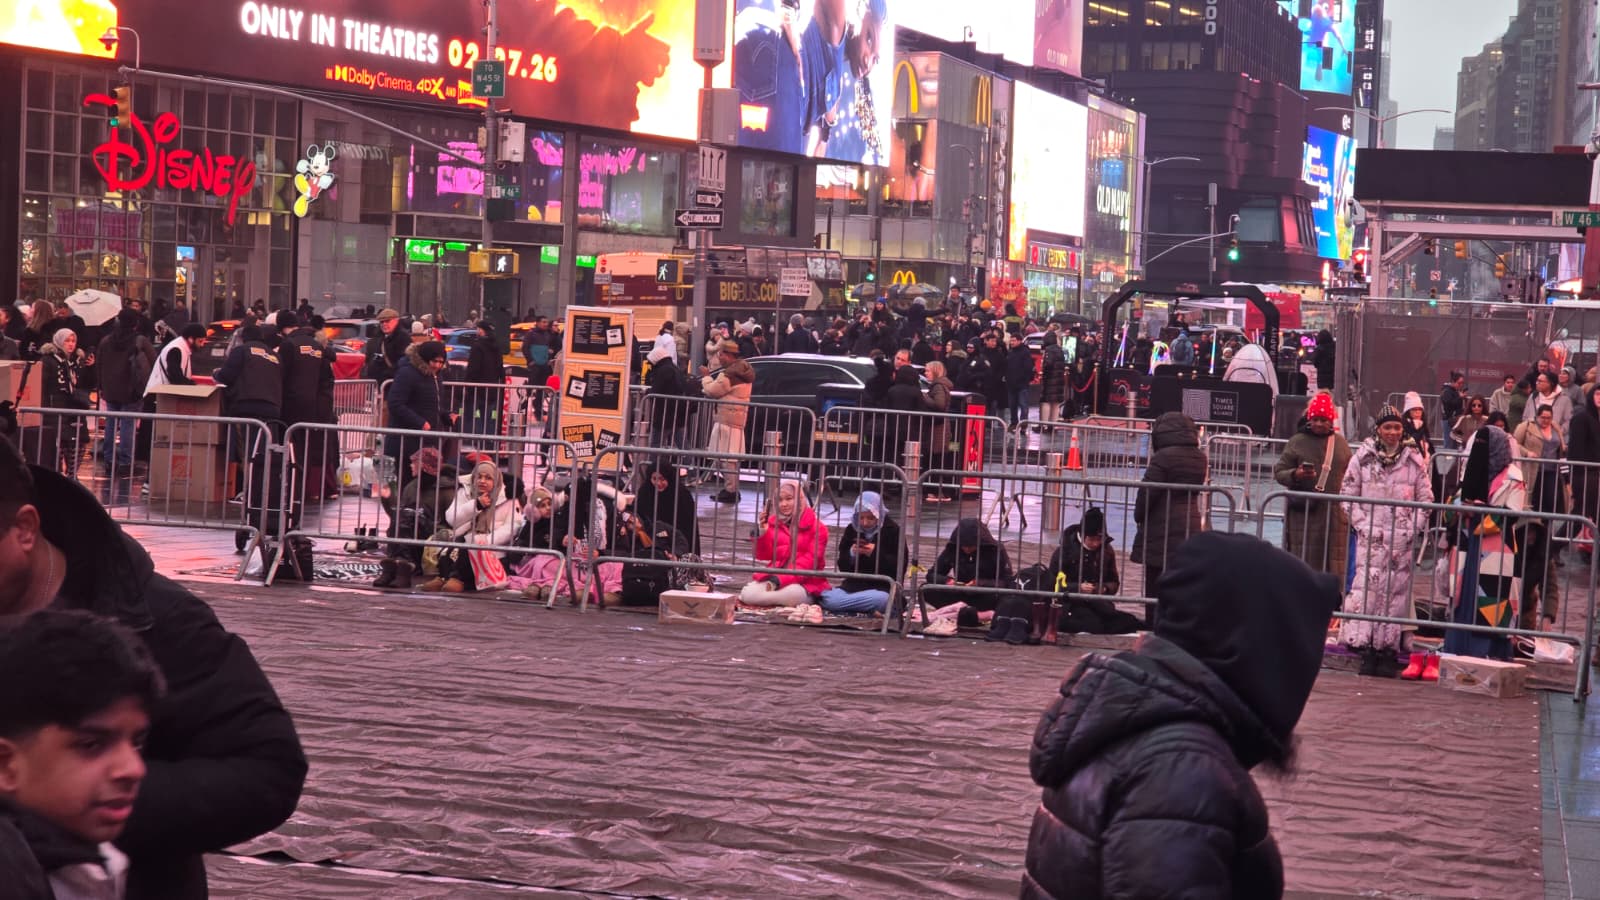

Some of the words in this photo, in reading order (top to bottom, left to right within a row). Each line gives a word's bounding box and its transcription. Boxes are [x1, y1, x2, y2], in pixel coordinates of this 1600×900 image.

[241, 1, 304, 41] ONLY
[310, 13, 336, 48] IN
[342, 19, 440, 65] THEATRES
[348, 66, 377, 91] Dolby
[416, 76, 446, 101] 4DX
[1097, 183, 1111, 214] OLD
[1110, 187, 1130, 218] NAVY
[702, 214, 718, 223] WAY
[1565, 213, 1575, 225] W
[1578, 213, 1592, 226] 46
